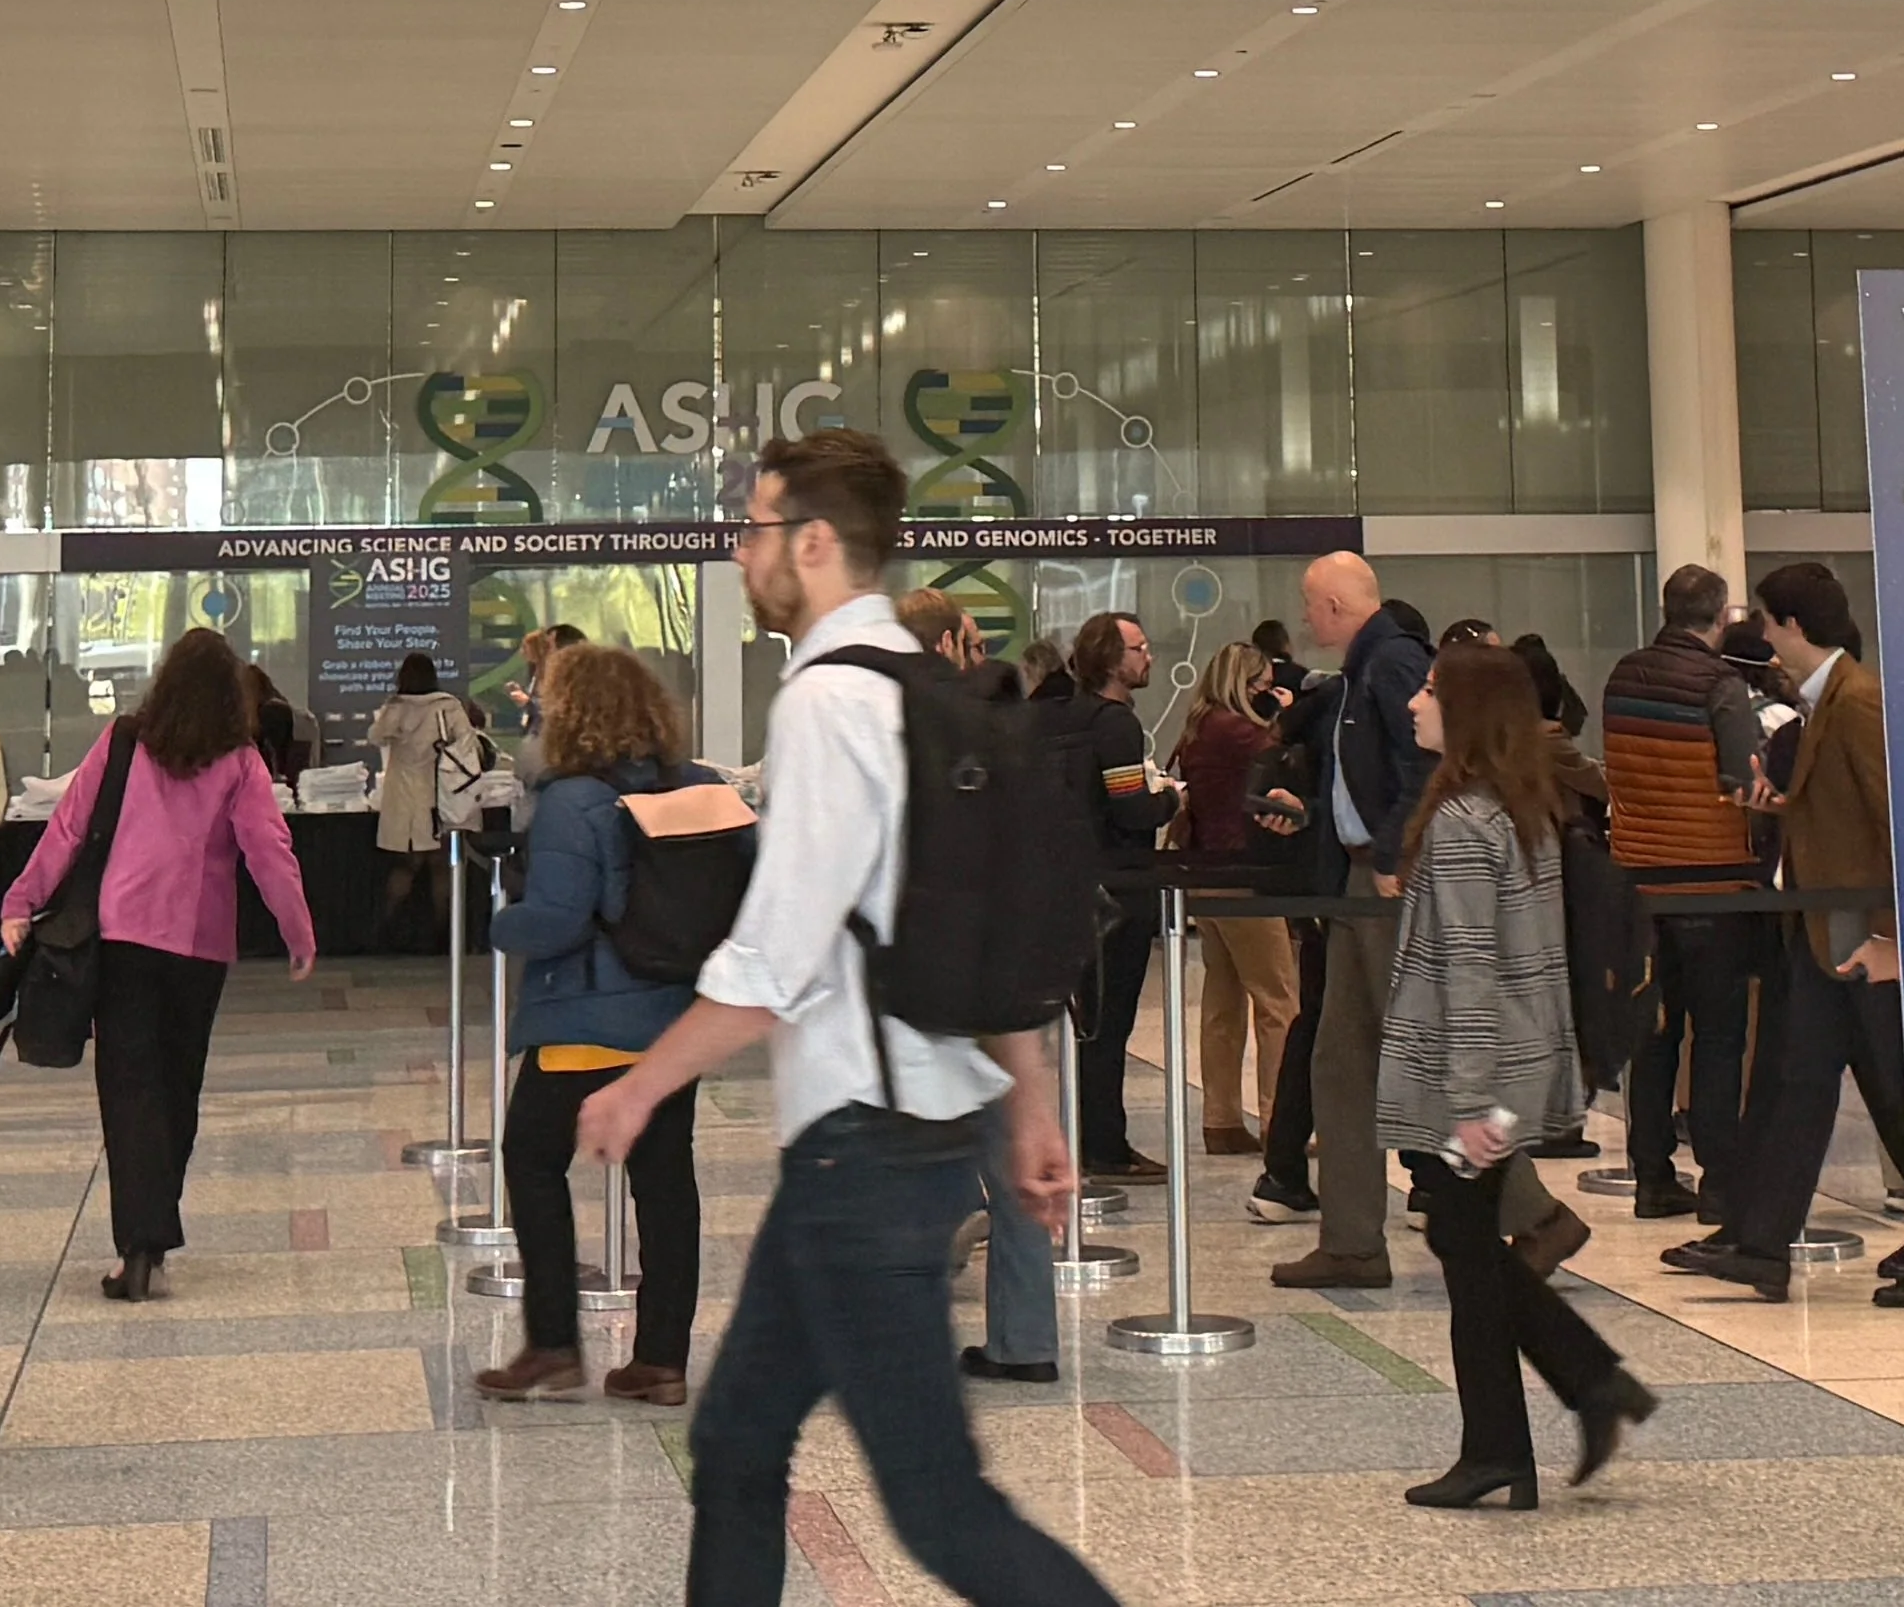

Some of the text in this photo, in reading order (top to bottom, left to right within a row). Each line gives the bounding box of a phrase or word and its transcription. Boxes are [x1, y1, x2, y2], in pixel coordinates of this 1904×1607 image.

[218, 537, 353, 558] ADVANCING
[361, 535, 452, 554] SCIENCE
[459, 535, 500, 553] AND
[514, 534, 604, 553] SOCIETY
[609, 532, 717, 551] THROUGH
[921, 530, 969, 547] AND
[975, 529, 1088, 547] GENOMICS
[1107, 528, 1217, 545] TOGETHER
[366, 557, 451, 582] ASHG
[407, 584, 451, 600] 2025
